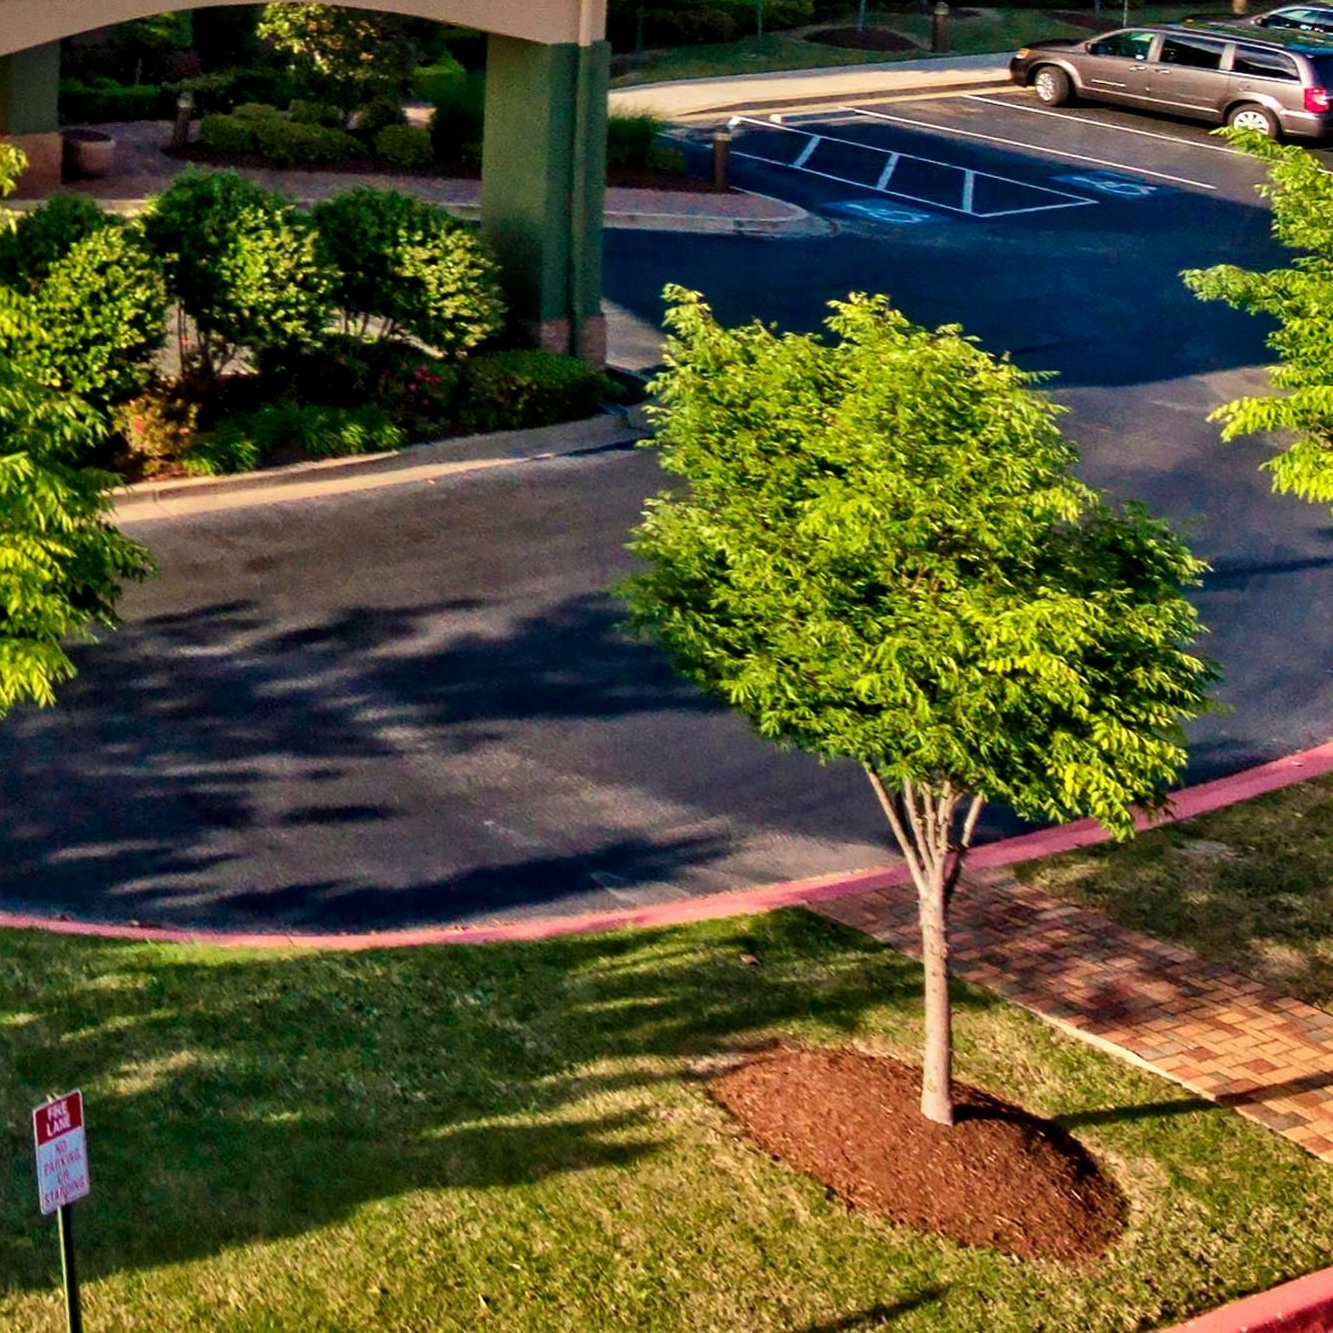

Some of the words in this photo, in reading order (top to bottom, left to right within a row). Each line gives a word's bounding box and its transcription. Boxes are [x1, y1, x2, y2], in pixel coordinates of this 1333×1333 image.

[46, 1100, 69, 1121] FIRE
[46, 1114, 71, 1137] LANE
[54, 1139, 68, 1155] NO
[43, 1148, 81, 1176] PARKING
